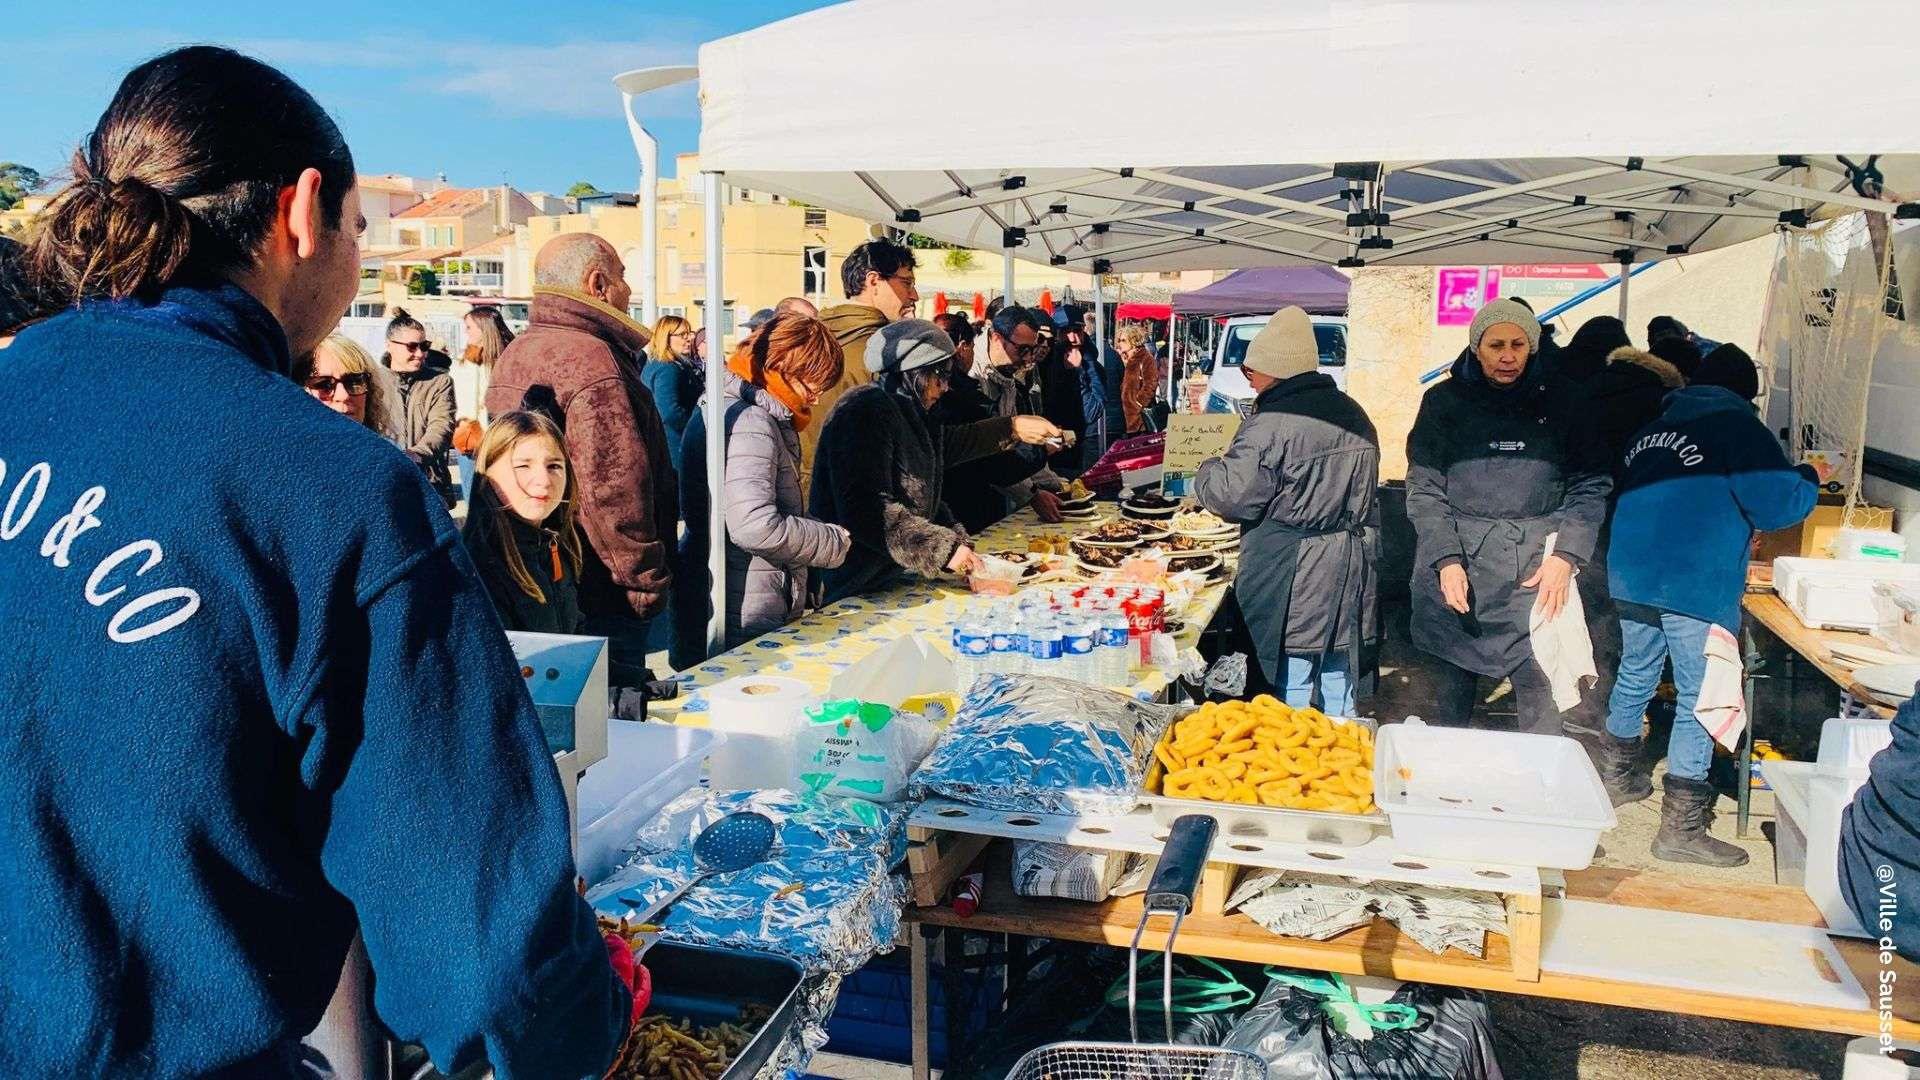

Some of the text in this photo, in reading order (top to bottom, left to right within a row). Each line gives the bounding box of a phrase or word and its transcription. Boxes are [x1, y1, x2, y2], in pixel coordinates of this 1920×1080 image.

[1679, 444, 1703, 466] CO
[40, 486, 106, 567] &
[85, 539, 201, 643] CO
